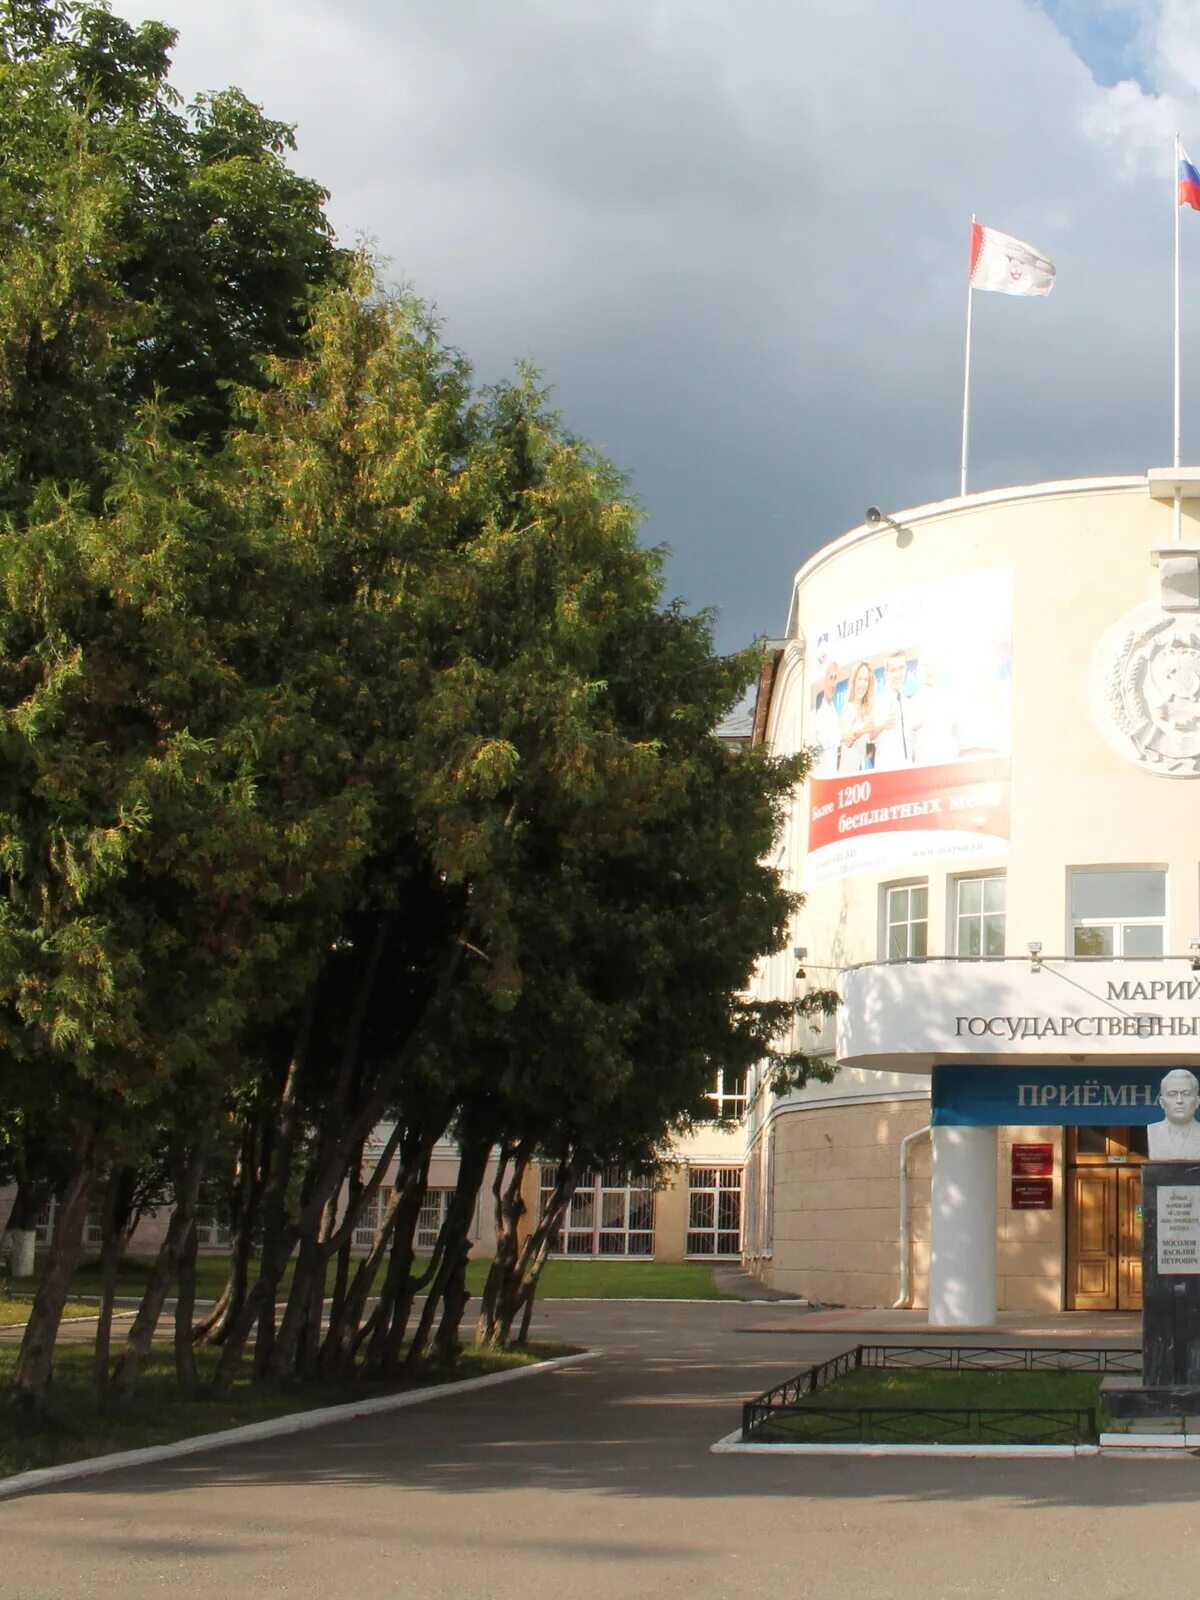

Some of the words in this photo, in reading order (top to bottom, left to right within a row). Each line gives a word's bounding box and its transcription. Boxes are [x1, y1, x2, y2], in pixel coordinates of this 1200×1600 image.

[836, 604, 888, 641] МарГУ
[837, 780, 872, 809] 1200
[838, 797, 943, 833] бесплатных
[1017, 1079, 1161, 1107] ПРИЁМН
[1161, 1239, 1197, 1247] МОСОЛОВ
[1163, 1248, 1195, 1256] ВАСИЛИЙ
